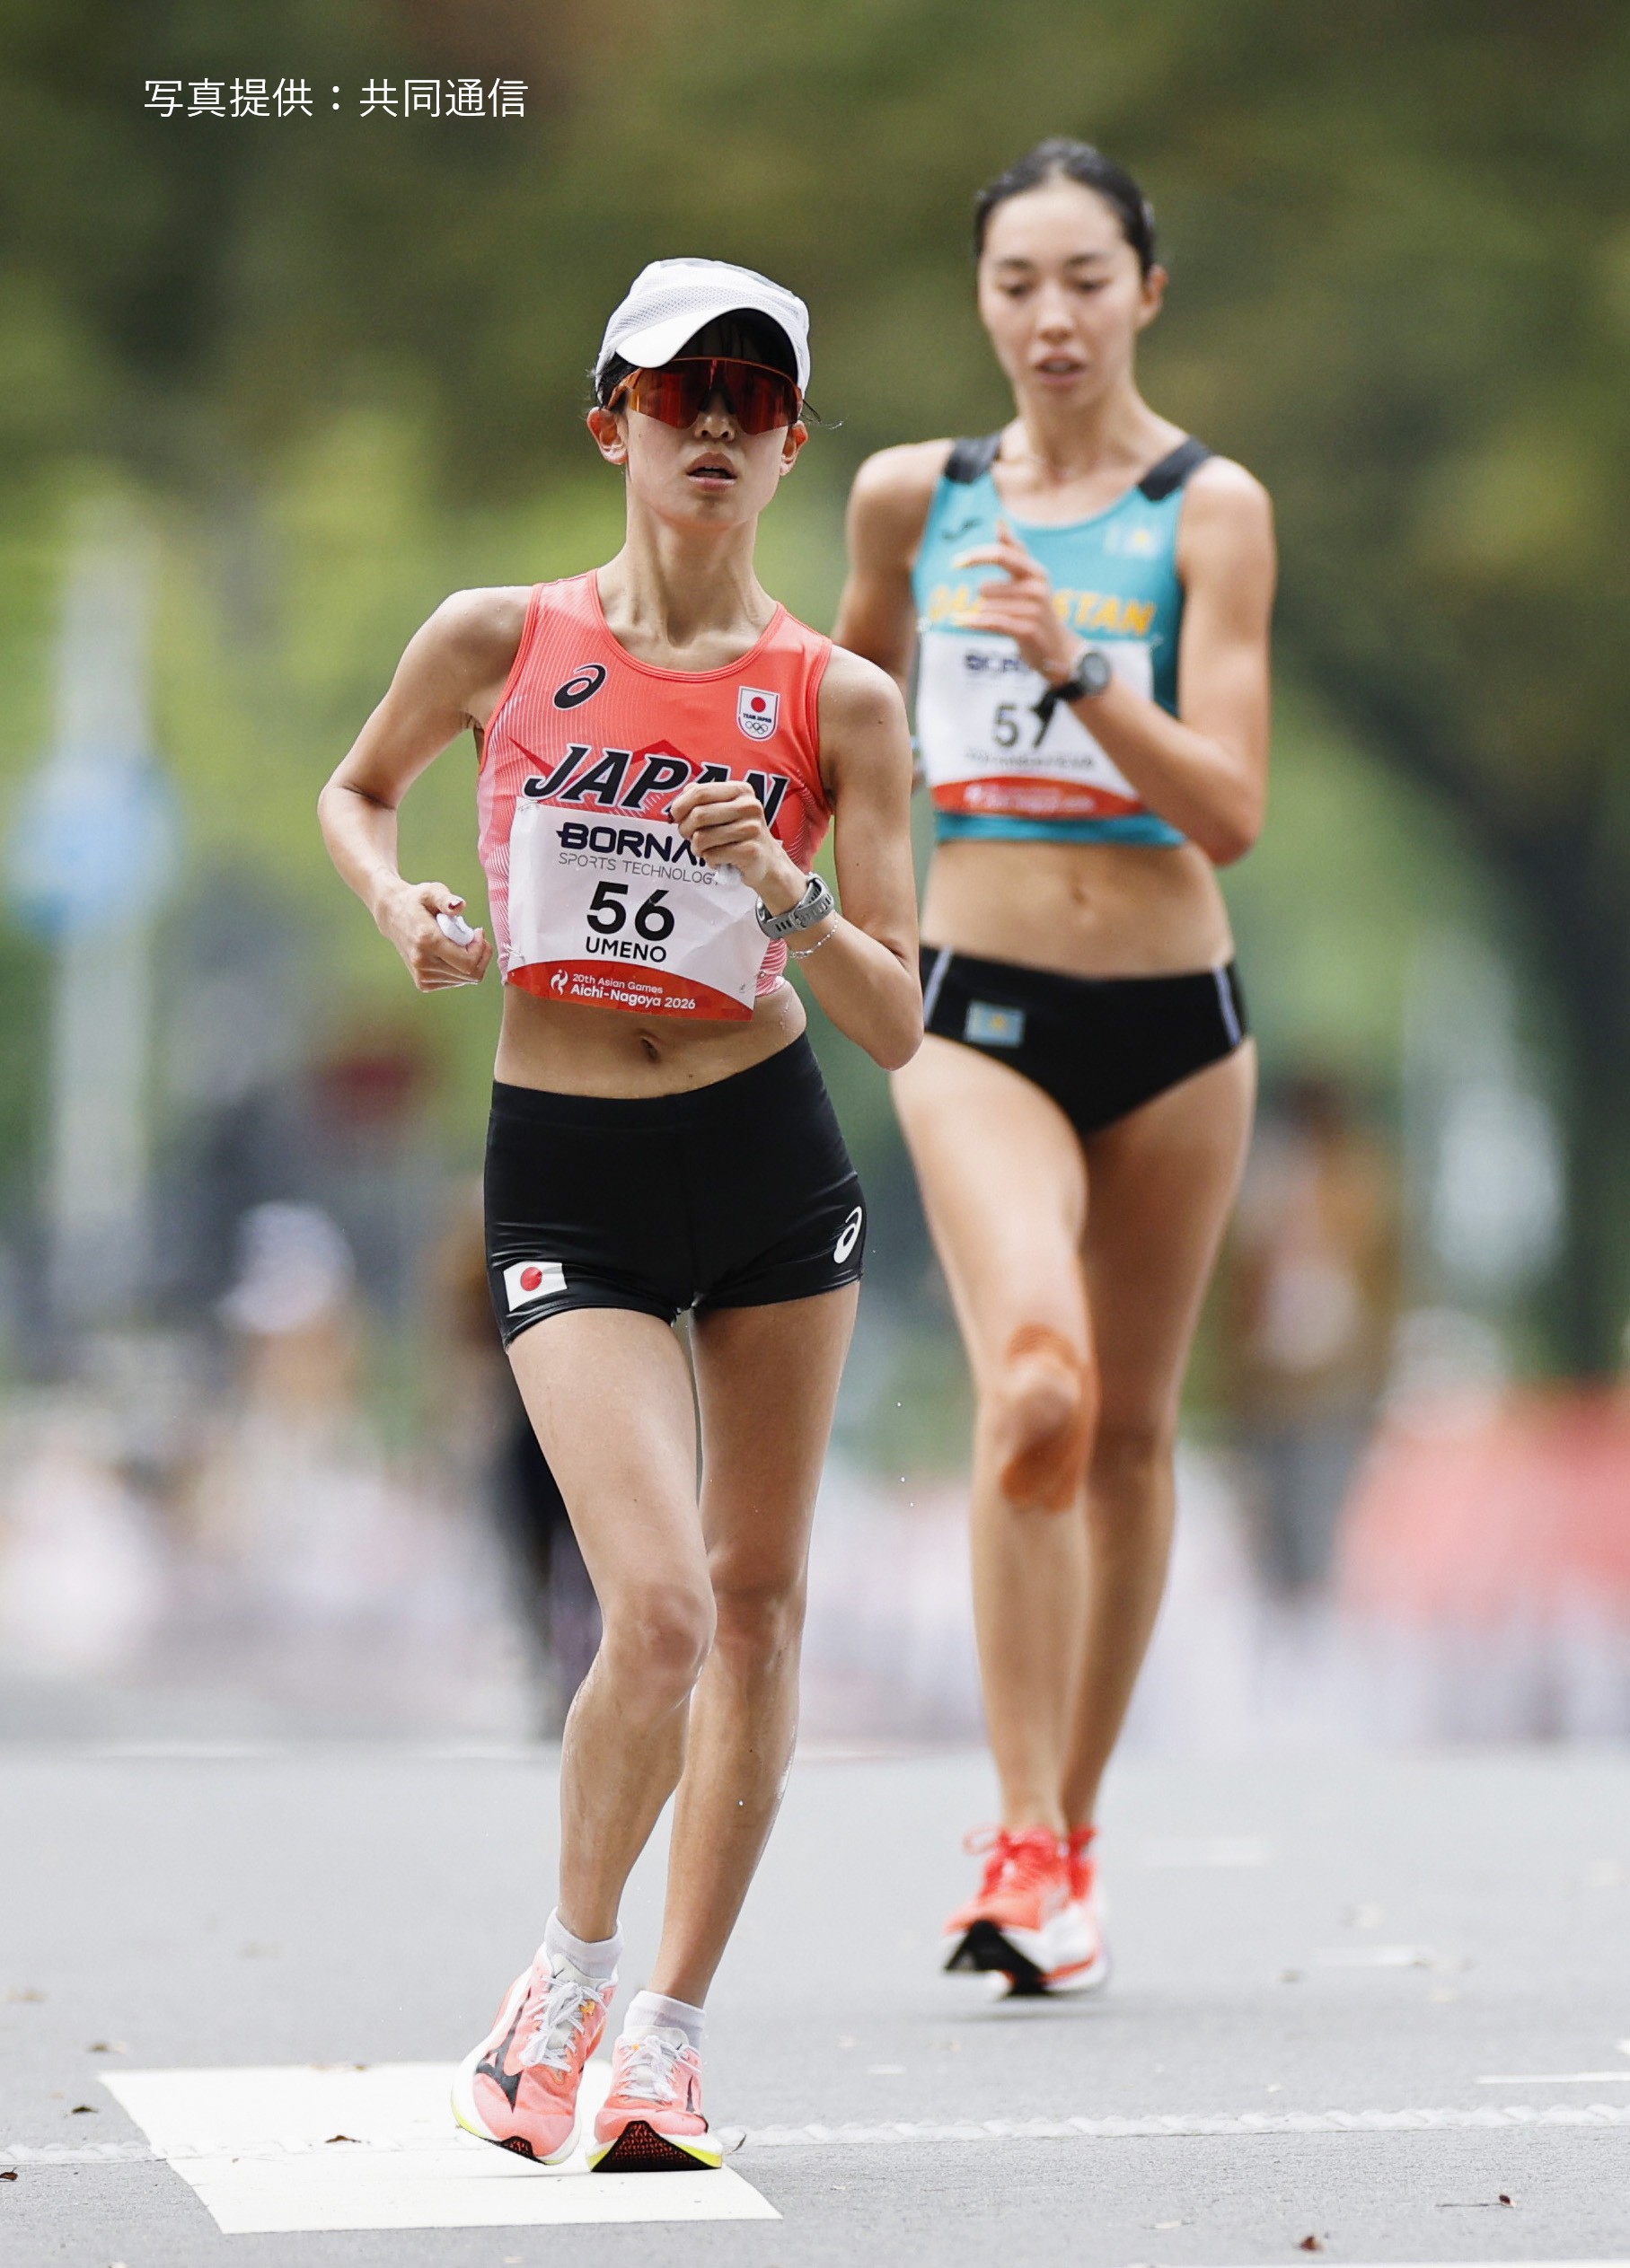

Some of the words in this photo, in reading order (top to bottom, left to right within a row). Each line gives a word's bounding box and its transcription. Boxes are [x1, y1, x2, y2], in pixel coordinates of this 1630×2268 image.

[556, 822, 707, 866] BORNA
[559, 853, 616, 870] SPORTS
[586, 880, 675, 942] 56
[586, 936, 667, 963] UMENO
[572, 973, 596, 985] 20th
[597, 976, 626, 990] Asian
[628, 980, 664, 994] Games
[571, 984, 662, 1008] Aichi-Nagoya
[664, 996, 696, 1011] 2026
